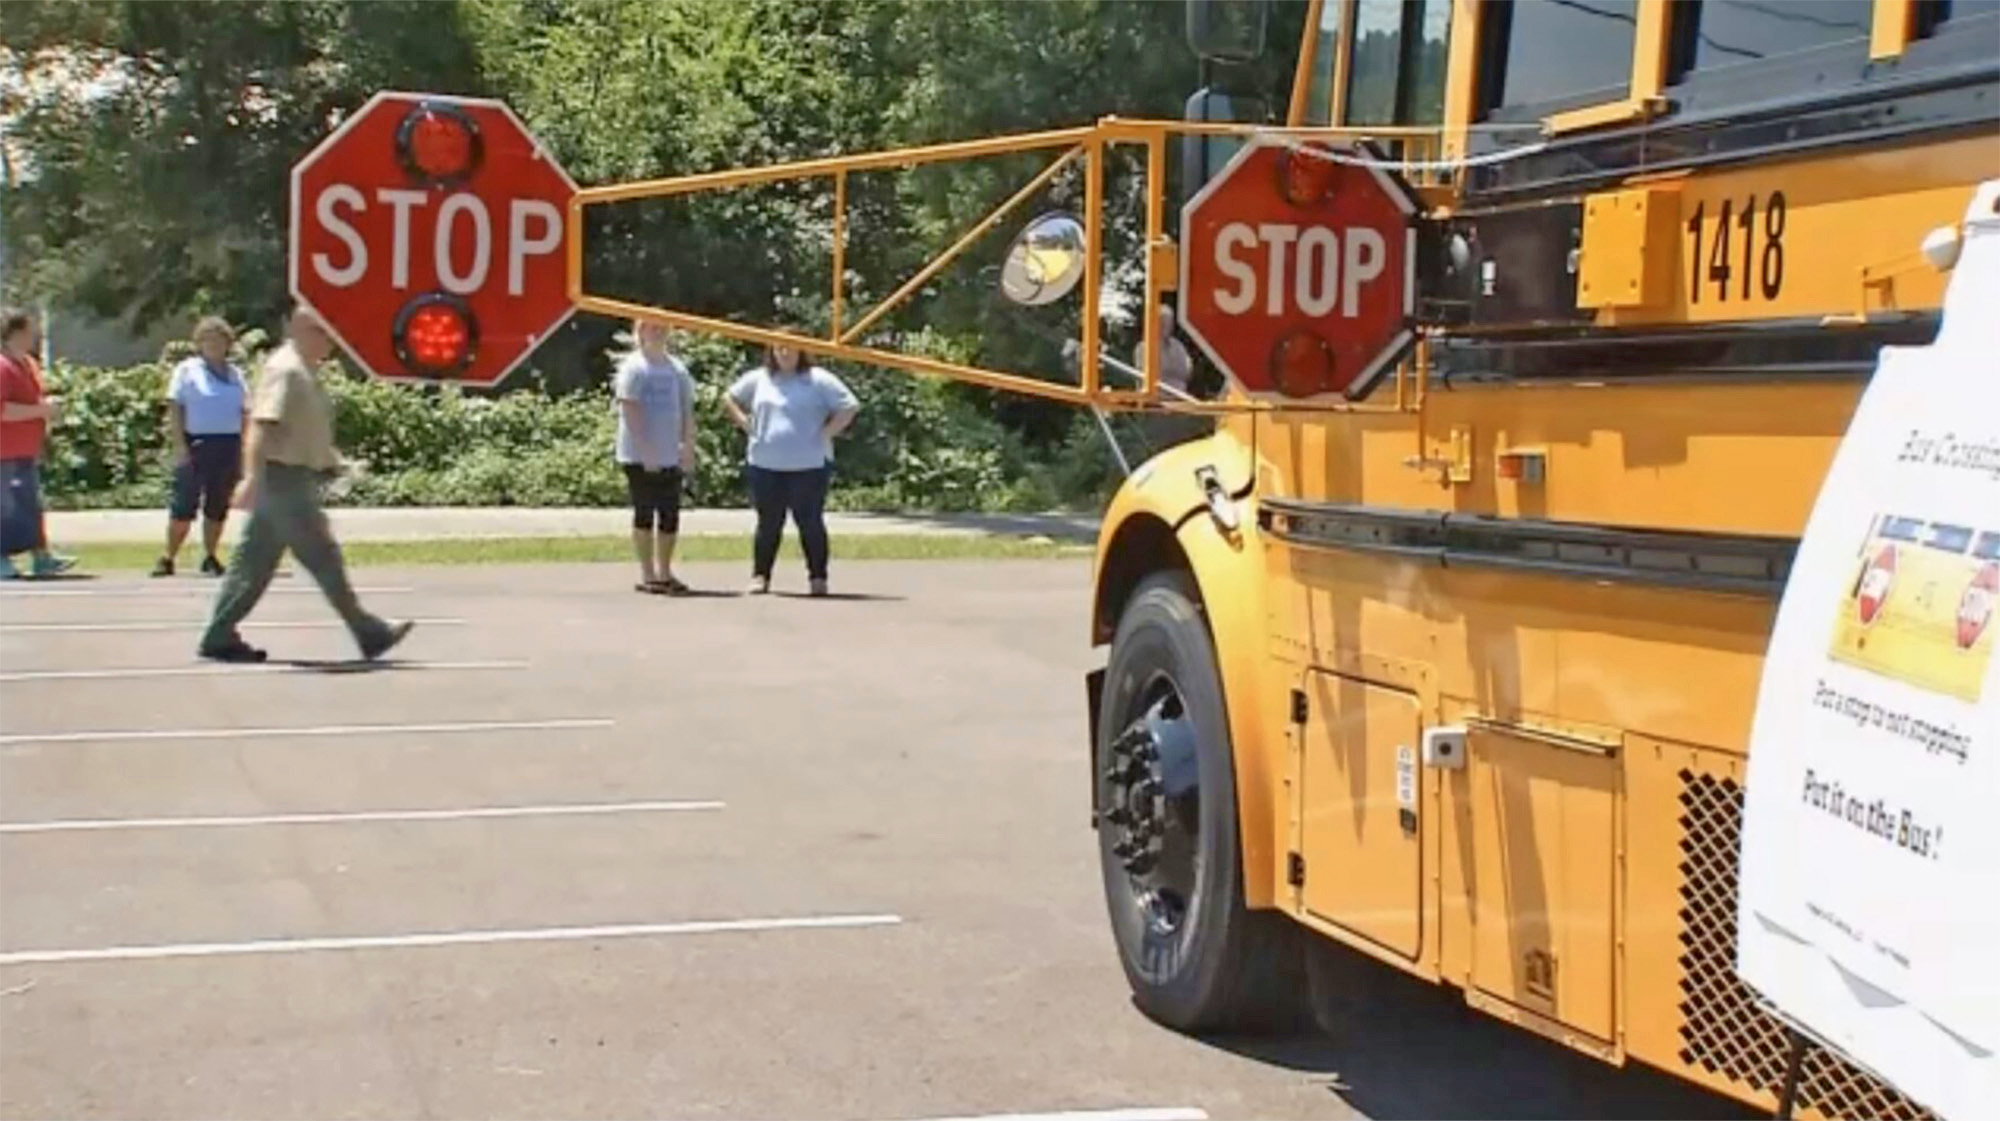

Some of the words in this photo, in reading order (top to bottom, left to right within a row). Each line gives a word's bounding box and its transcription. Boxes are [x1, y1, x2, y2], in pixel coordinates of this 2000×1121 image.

[311, 183, 563, 295] STOP
[1213, 222, 1386, 318] STOP
[1688, 190, 1787, 302] 1418
[1802, 768, 1830, 811] Put
[1829, 781, 1845, 818] it
[1846, 797, 1865, 830] on
[1866, 799, 1896, 841] the
